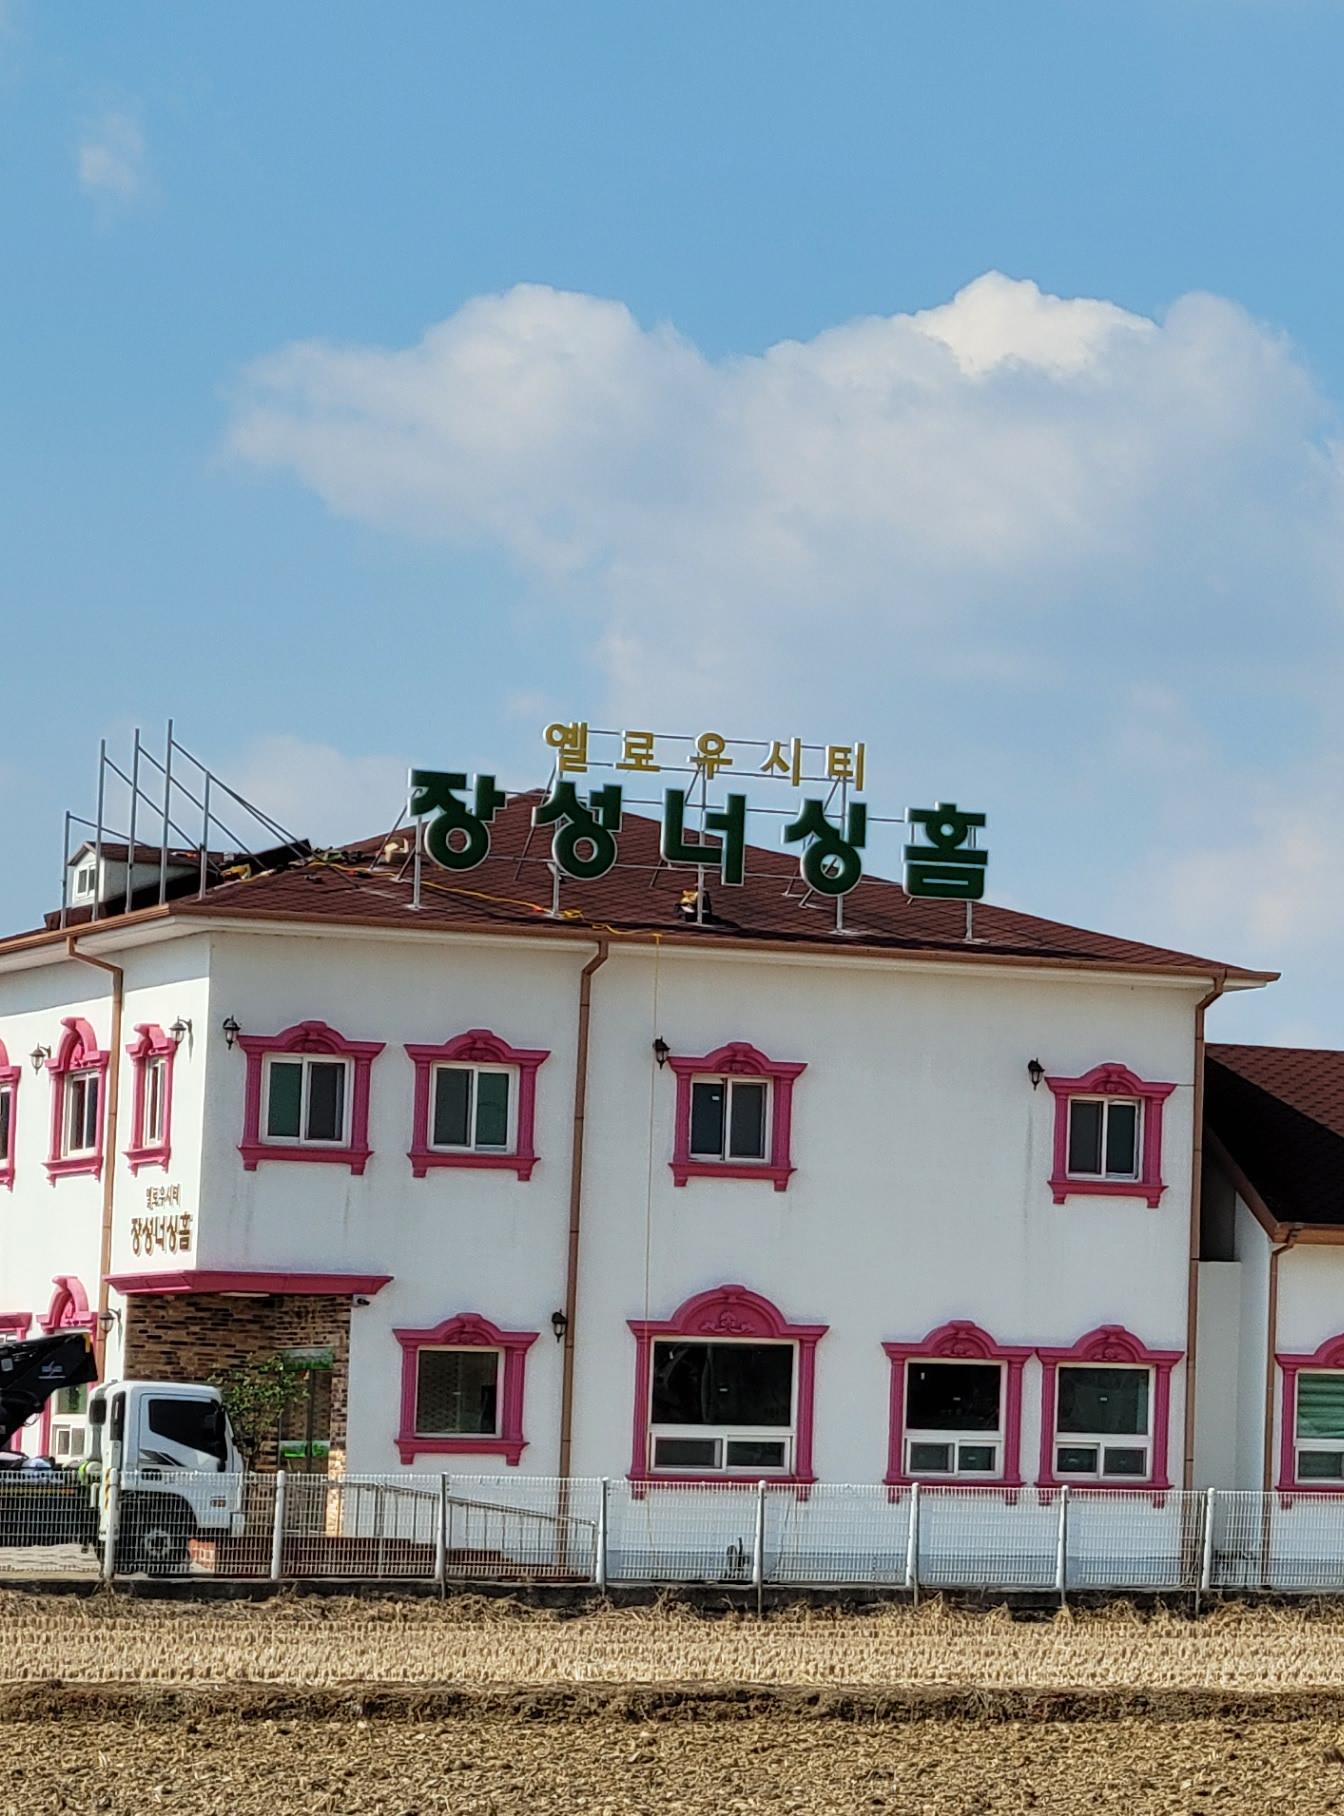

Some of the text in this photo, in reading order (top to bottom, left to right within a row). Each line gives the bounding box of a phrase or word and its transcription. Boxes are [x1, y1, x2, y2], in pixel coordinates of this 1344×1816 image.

[543, 721, 866, 791] 옐로우시티
[408, 767, 989, 900] 장성너싱홈
[131, 1211, 193, 1256] 장성너싱홈
